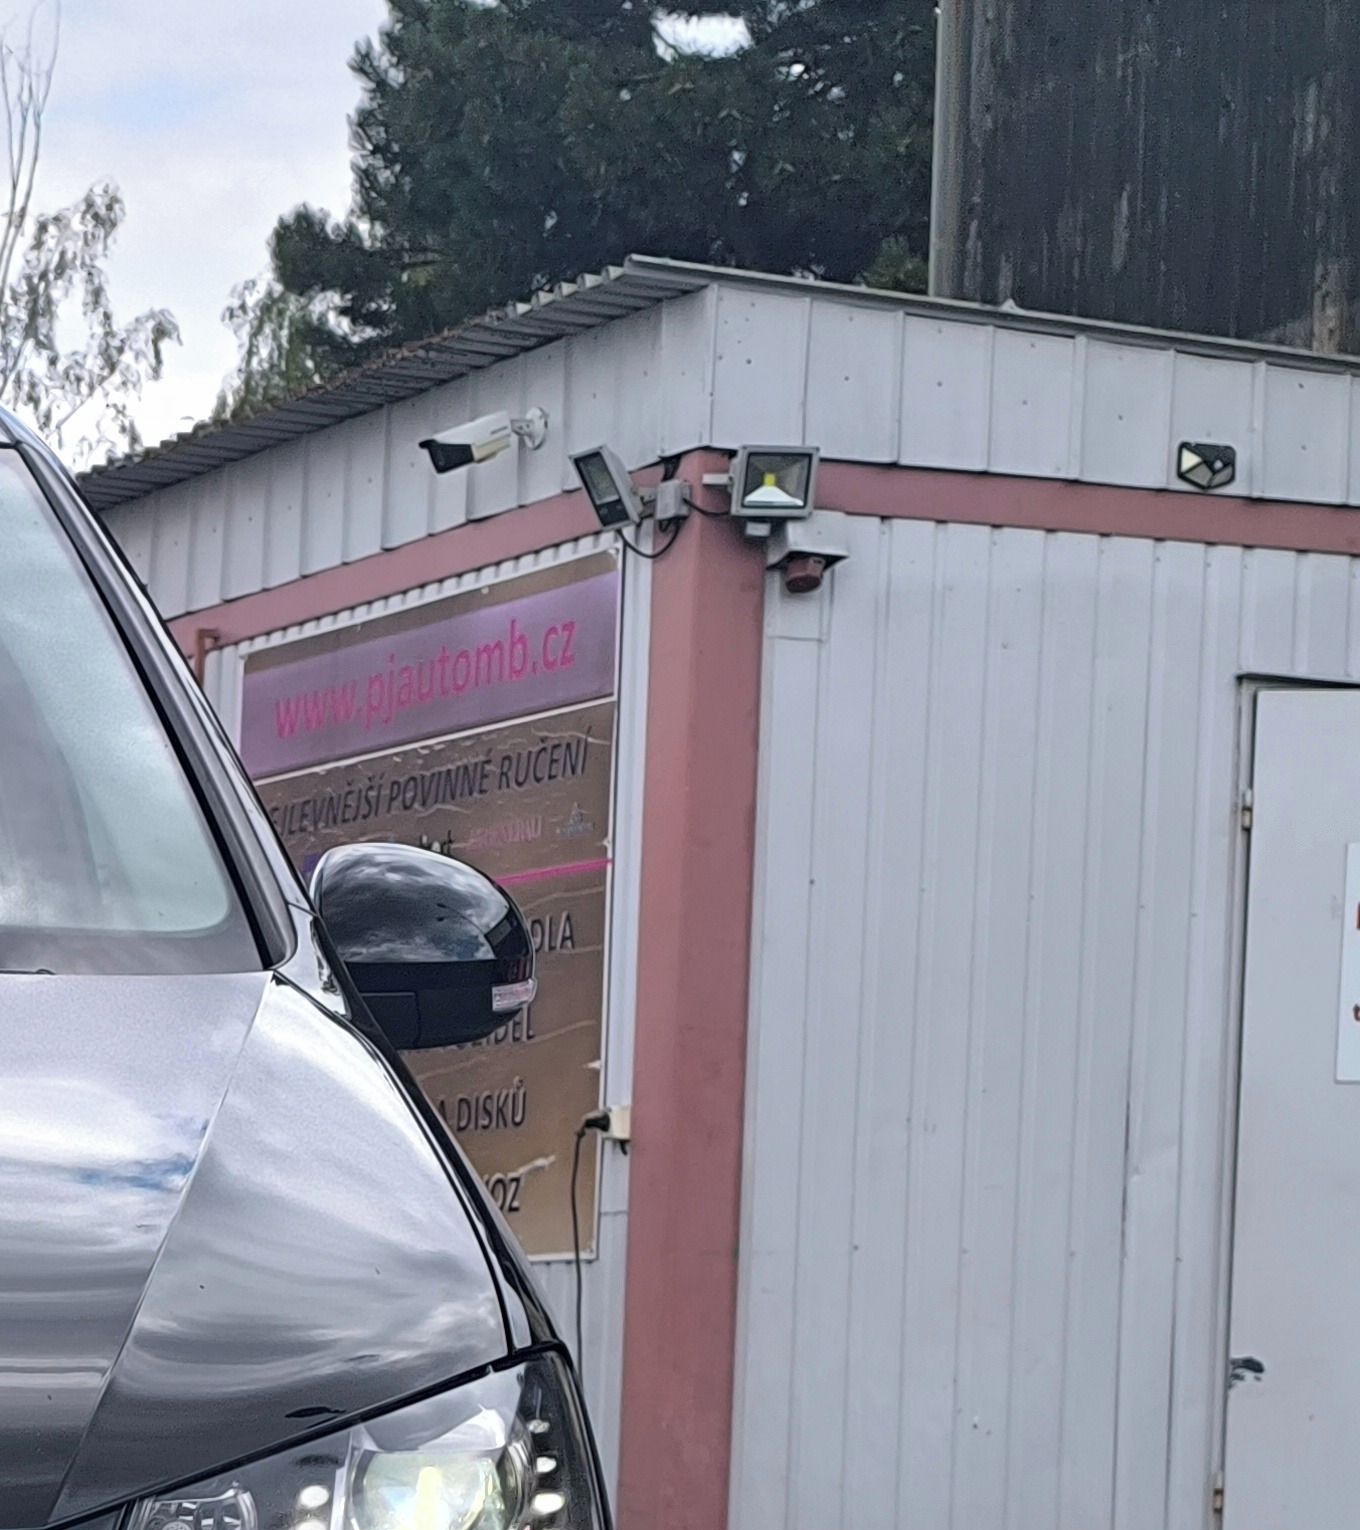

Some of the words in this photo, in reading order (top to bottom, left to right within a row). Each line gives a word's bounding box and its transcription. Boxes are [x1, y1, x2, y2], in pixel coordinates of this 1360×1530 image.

[275, 618, 577, 739] www.pjautomb.cz
[386, 748, 492, 814] POVINNÉ
[497, 725, 592, 790] RUČENÍ
[456, 1078, 527, 1132] DISKŮ
[484, 1175, 521, 1213] OZ
